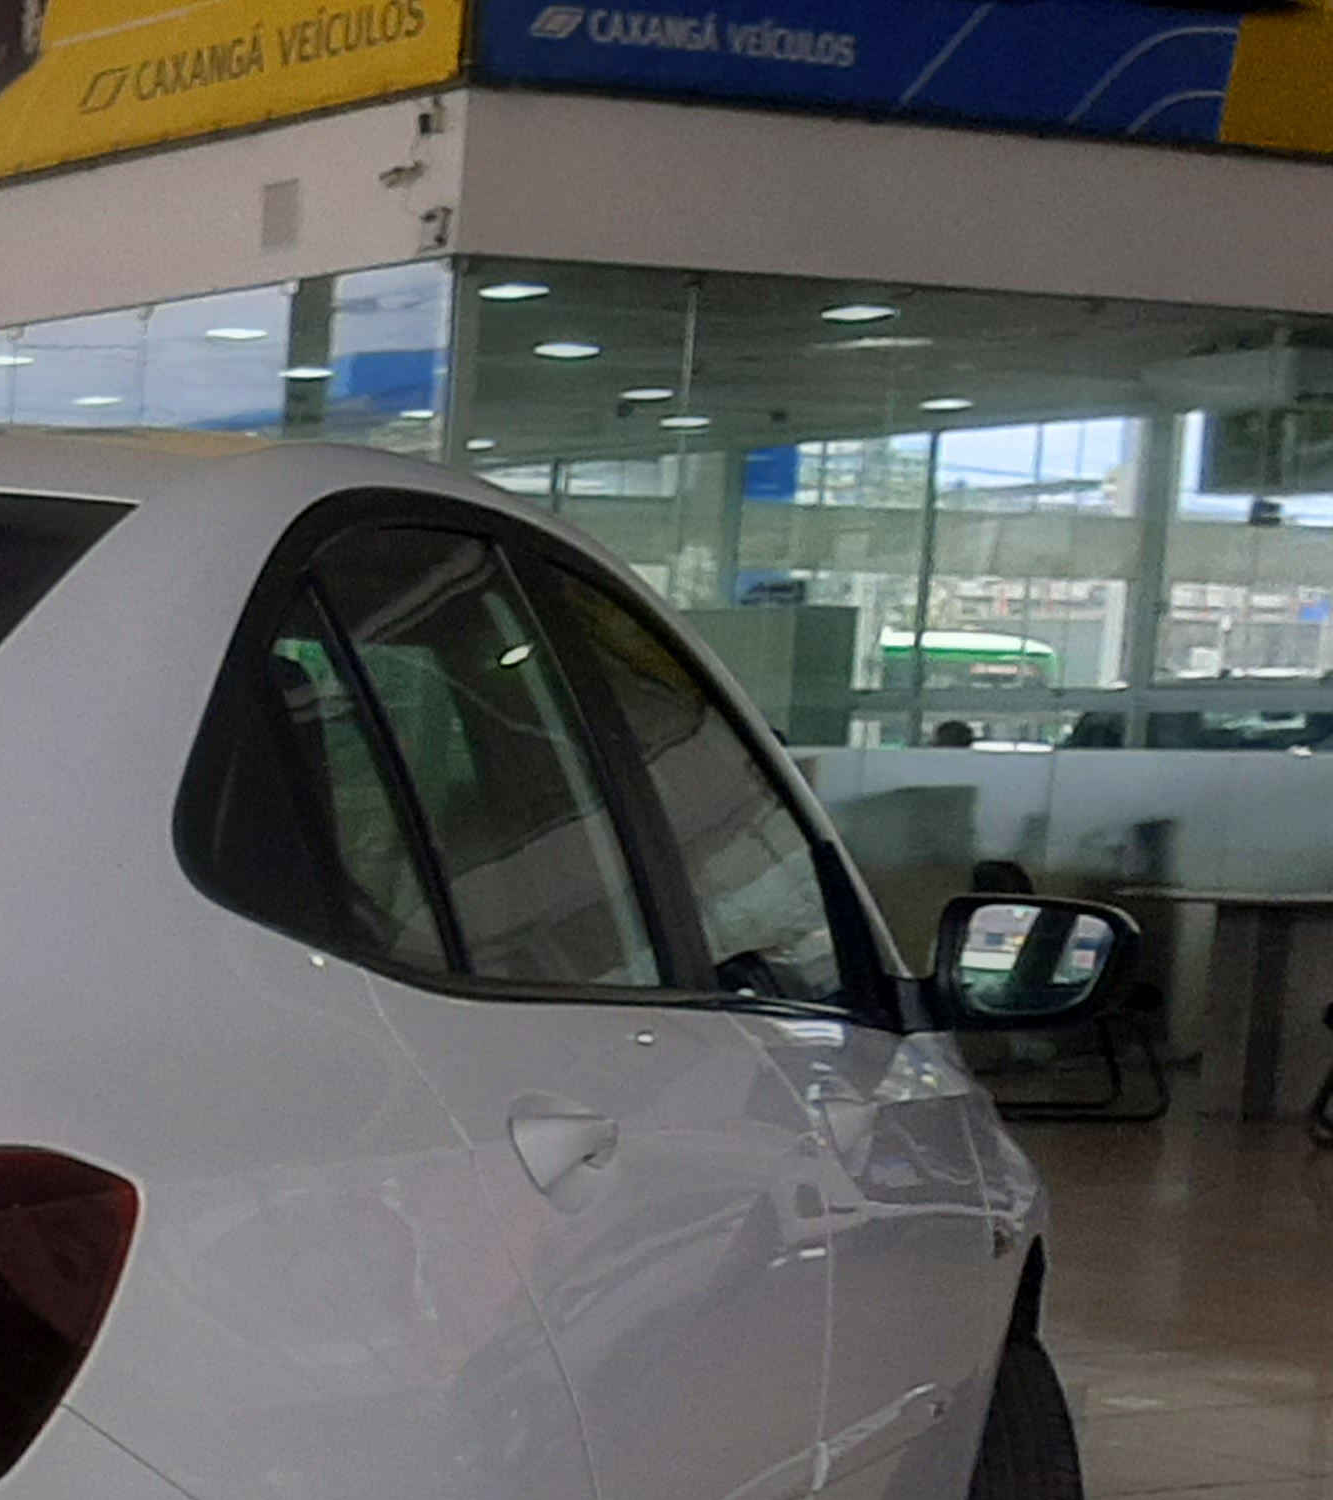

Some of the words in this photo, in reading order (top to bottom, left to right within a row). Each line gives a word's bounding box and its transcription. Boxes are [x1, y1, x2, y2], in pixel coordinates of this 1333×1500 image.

[136, 20, 264, 101] CAXANGÁ
[278, 0, 426, 67] VEÍCULOS
[588, 10, 719, 51] CAXANGÁ
[728, 18, 856, 67] VEÍCULOS
